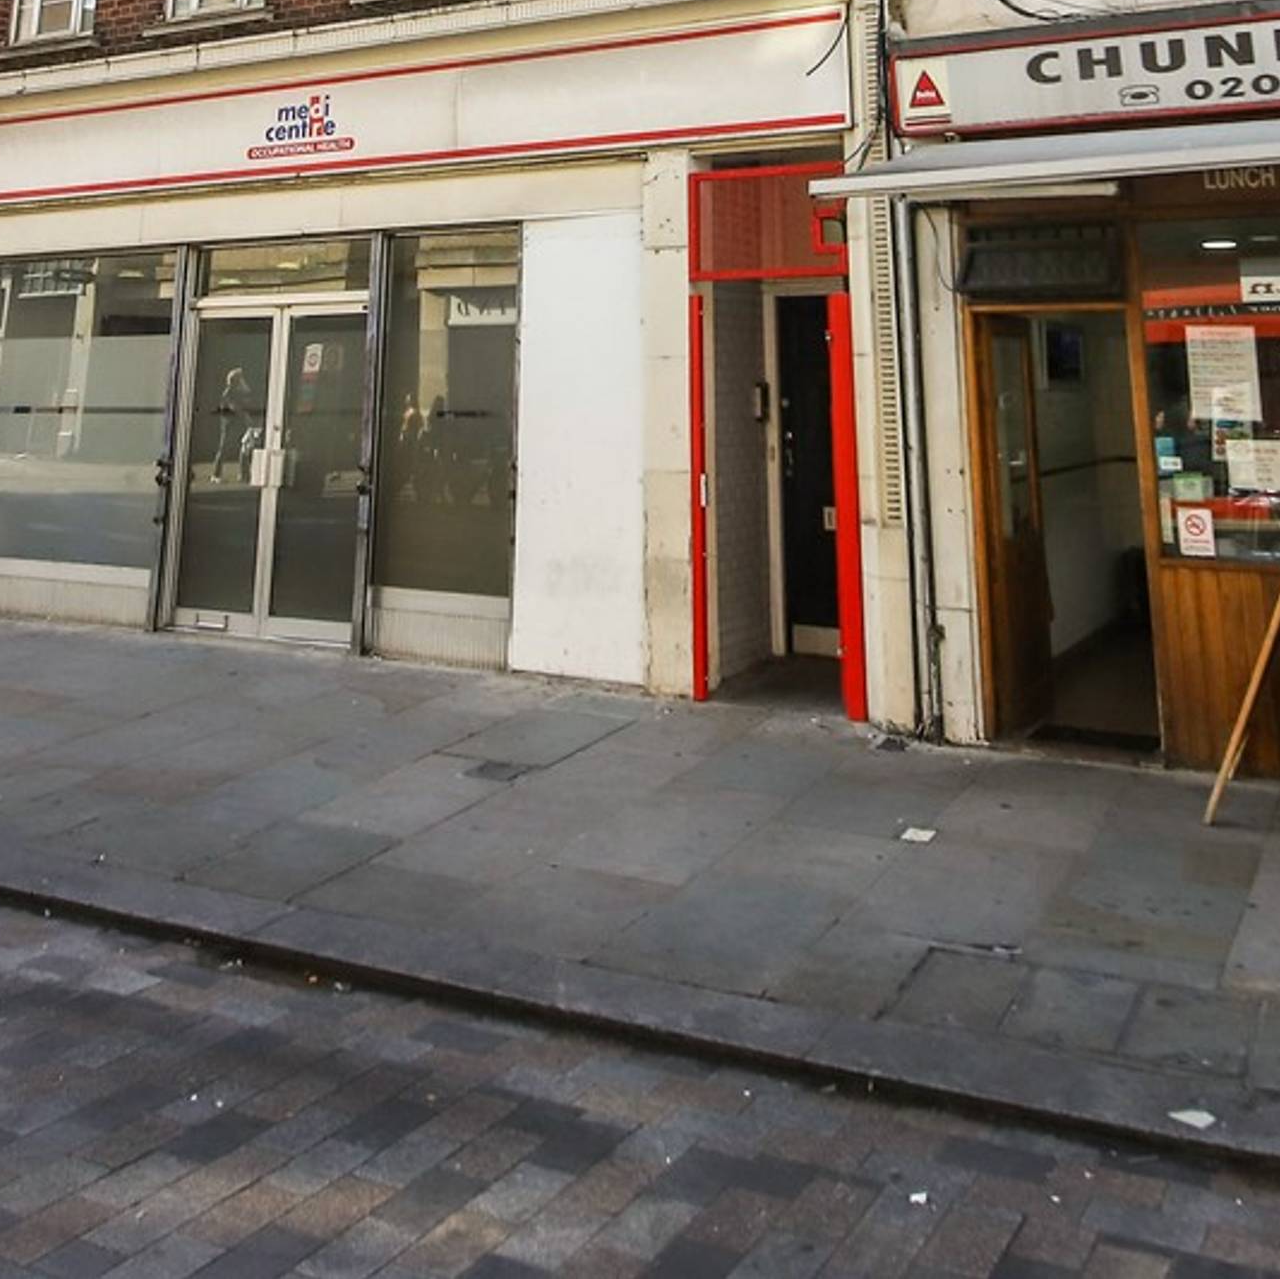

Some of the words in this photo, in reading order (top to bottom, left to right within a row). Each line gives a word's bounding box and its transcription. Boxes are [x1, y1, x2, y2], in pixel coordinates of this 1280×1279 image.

[1185, 74, 1280, 101] 020
[277, 94, 331, 121] medi
[265, 120, 336, 142] centre
[1204, 166, 1275, 189] LUNCH
